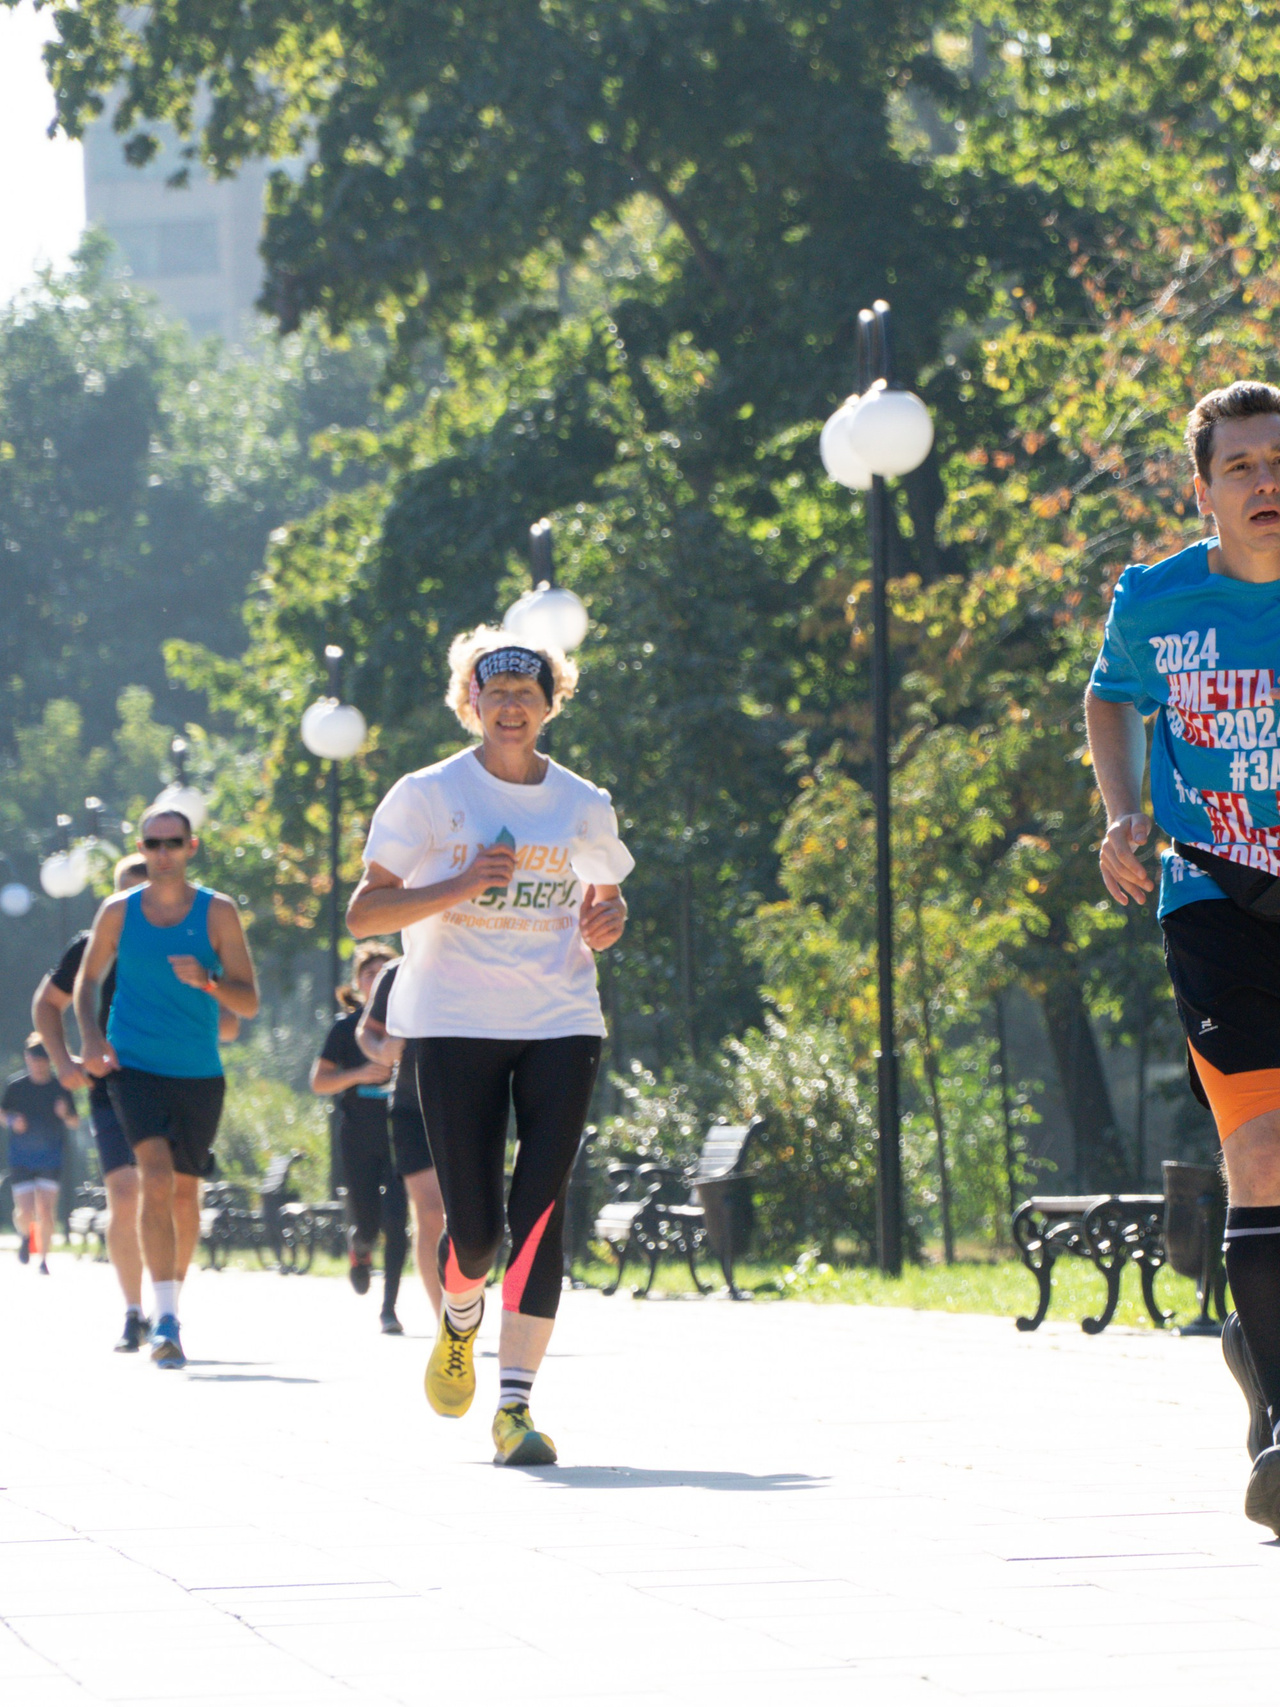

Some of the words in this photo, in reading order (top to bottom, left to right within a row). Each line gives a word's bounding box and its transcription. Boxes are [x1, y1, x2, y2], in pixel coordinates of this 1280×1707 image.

[1149, 627, 1220, 673] 2024
[1167, 669, 1274, 712] #МЕЧТА
[451, 844, 468, 870] Я
[512, 880, 577, 909] БЕГУ,
